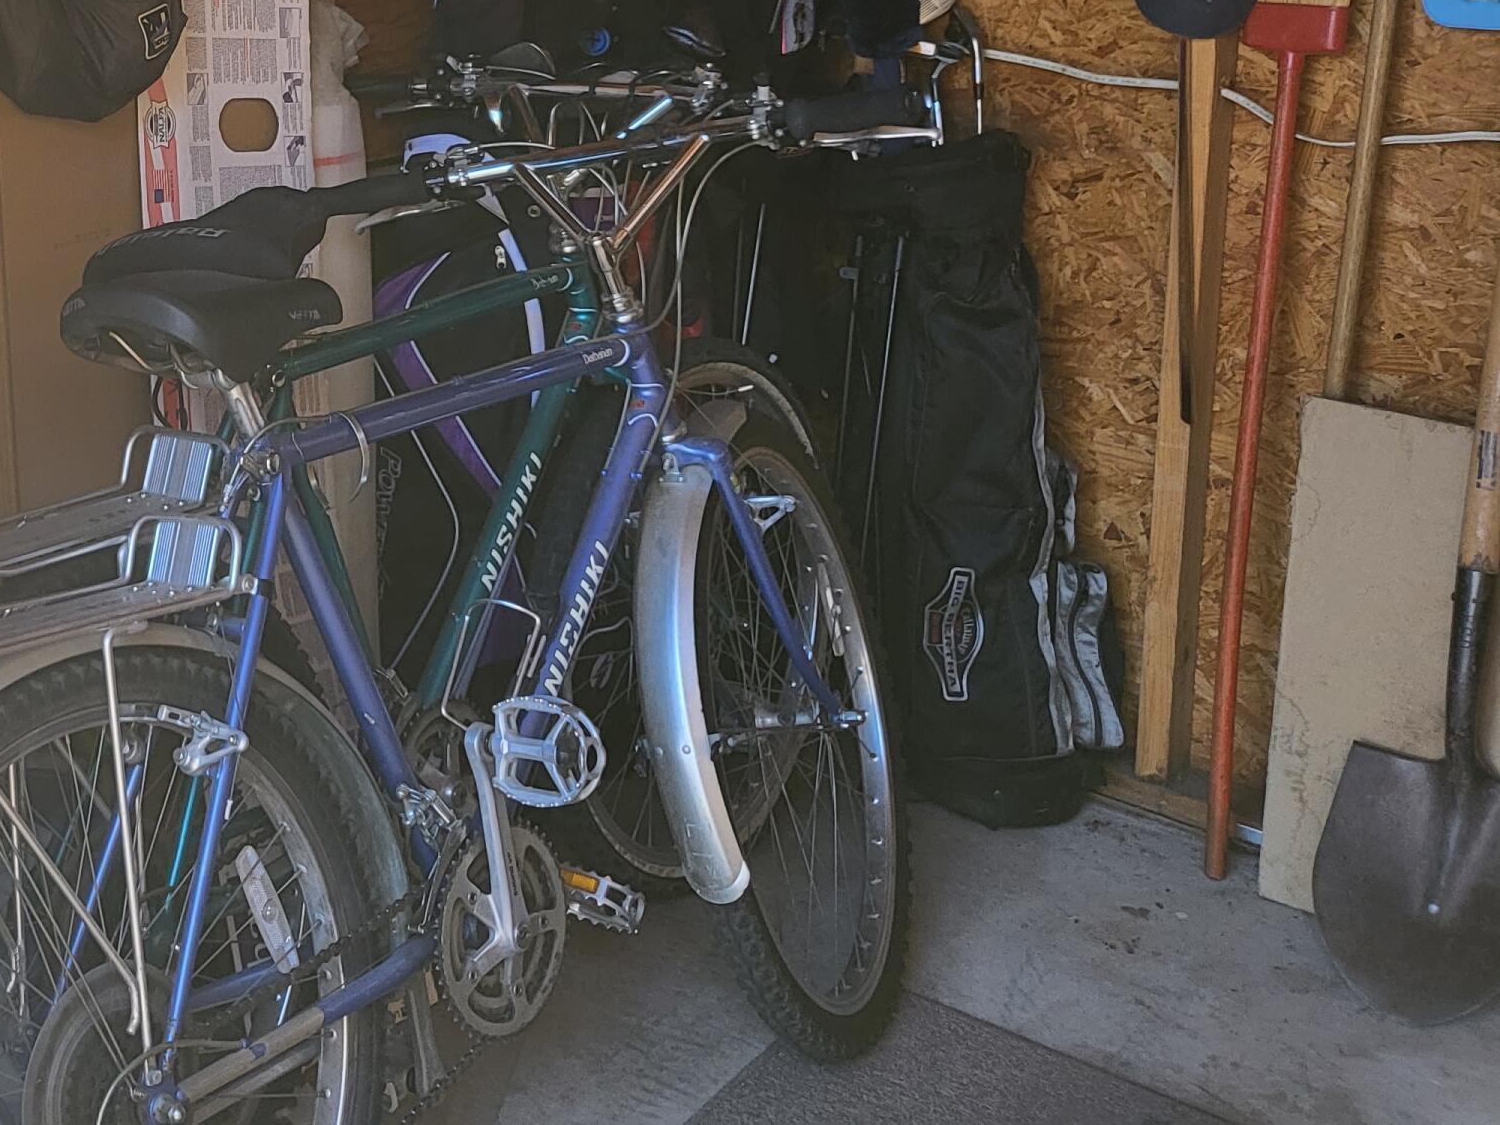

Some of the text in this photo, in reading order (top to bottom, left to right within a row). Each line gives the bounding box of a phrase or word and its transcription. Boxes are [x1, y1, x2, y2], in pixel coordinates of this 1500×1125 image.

[480, 451, 543, 593] NISHIKI
[543, 539, 610, 697] NISHIKI
[944, 580, 965, 687] BIG BERTHA
